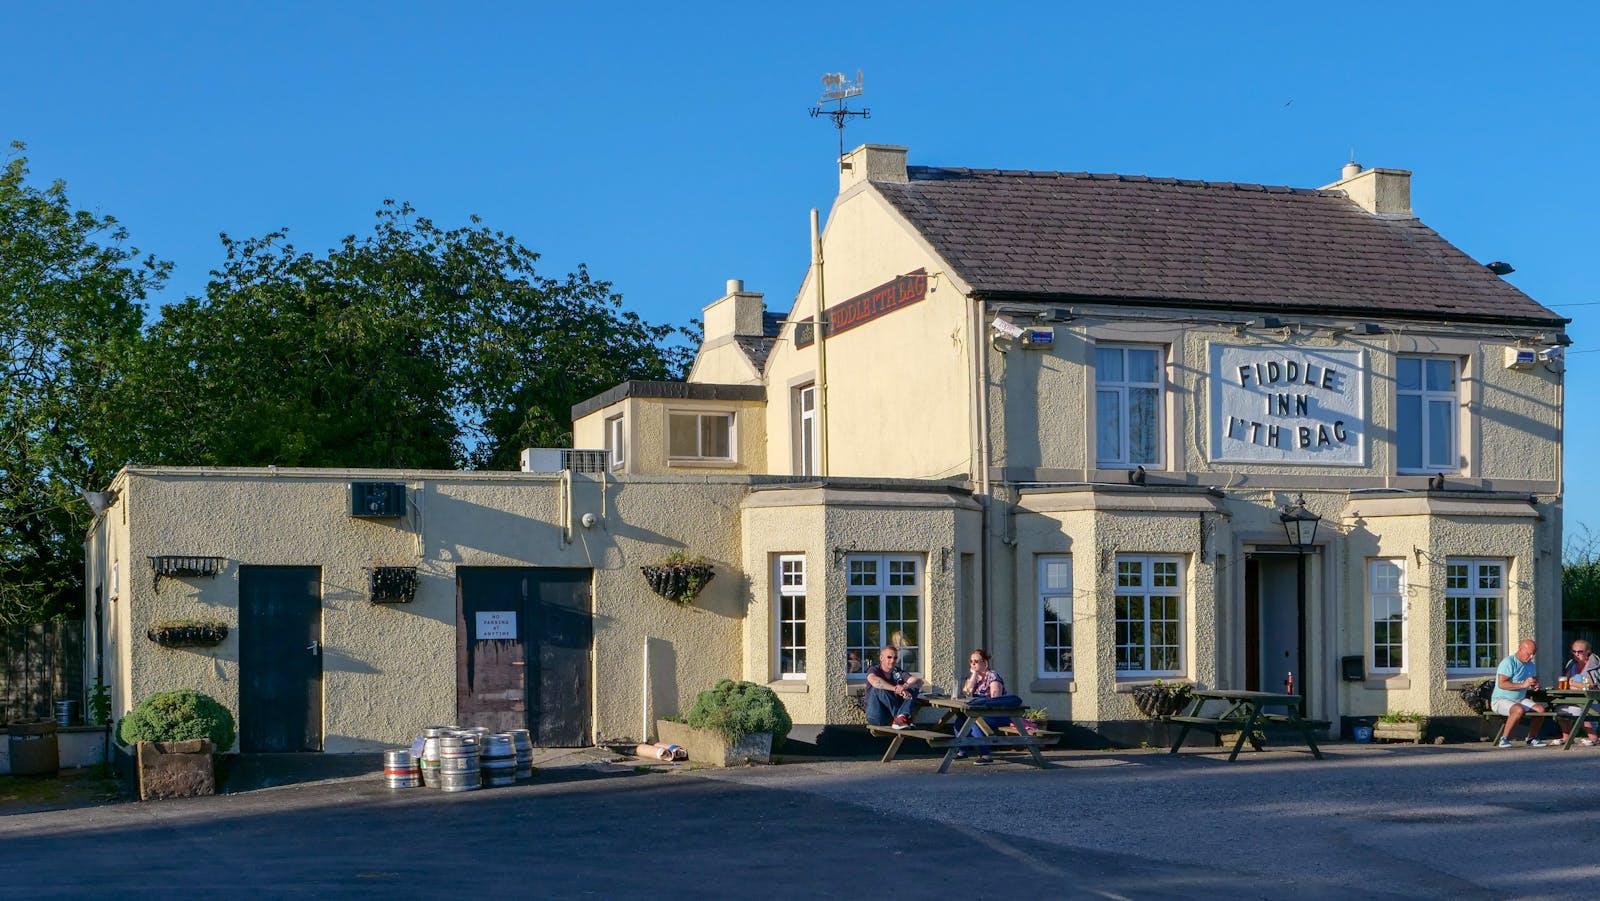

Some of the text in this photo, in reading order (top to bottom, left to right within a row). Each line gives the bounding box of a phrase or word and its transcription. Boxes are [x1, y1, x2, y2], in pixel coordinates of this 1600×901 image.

[831, 297, 870, 331] FIDDLE
[1237, 361, 1336, 391] FIDDLE
[1266, 393, 1308, 417] INN
[1226, 415, 1347, 449] I'TH BAG
